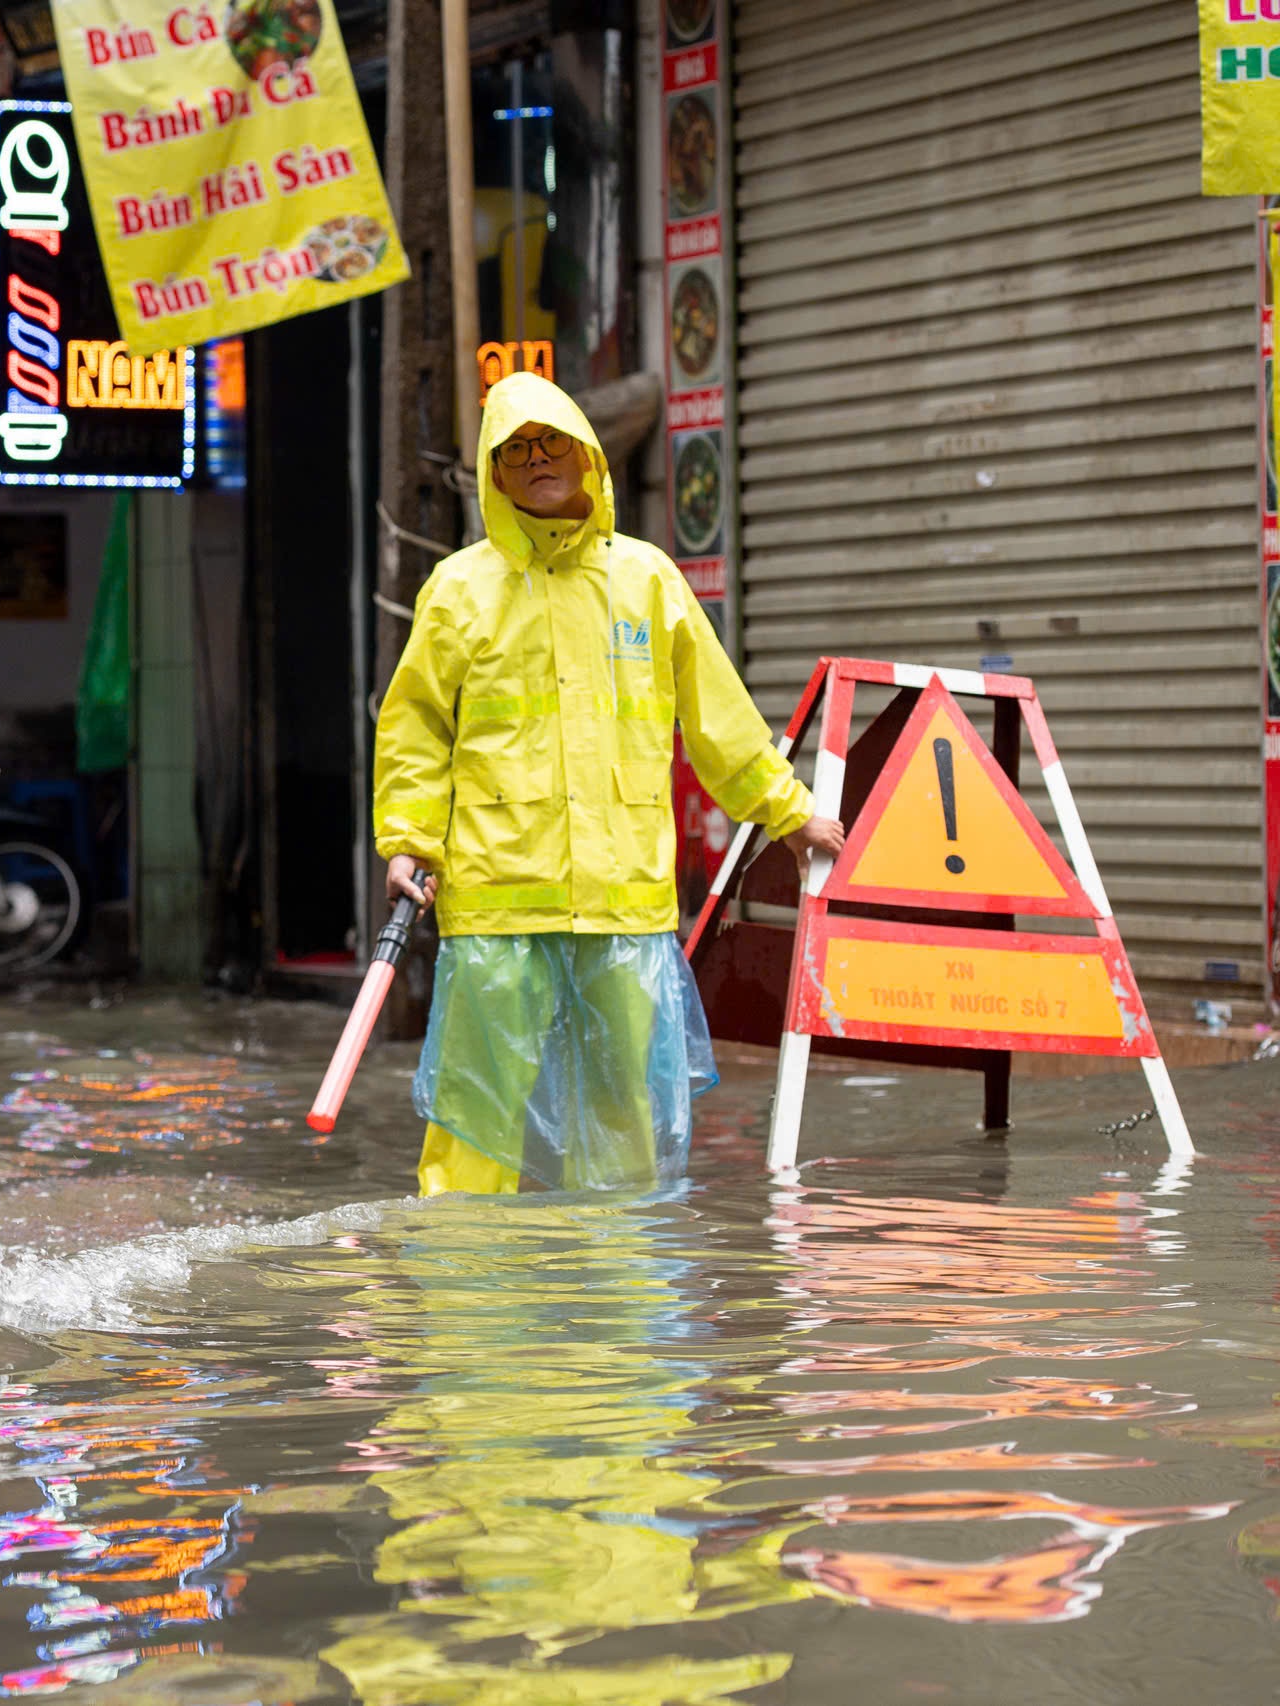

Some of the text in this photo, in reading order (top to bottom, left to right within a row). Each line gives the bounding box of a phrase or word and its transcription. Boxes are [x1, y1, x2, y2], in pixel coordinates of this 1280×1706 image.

[87, 4, 218, 65] Bún Cá
[101, 99, 204, 151] Bánh
[261, 58, 316, 105] Cá
[118, 147, 353, 236] Bún Hải Sản
[134, 248, 315, 319] Bún Trộn
[945, 962, 974, 980] XN
[1056, 1000, 1068, 1019] 7
